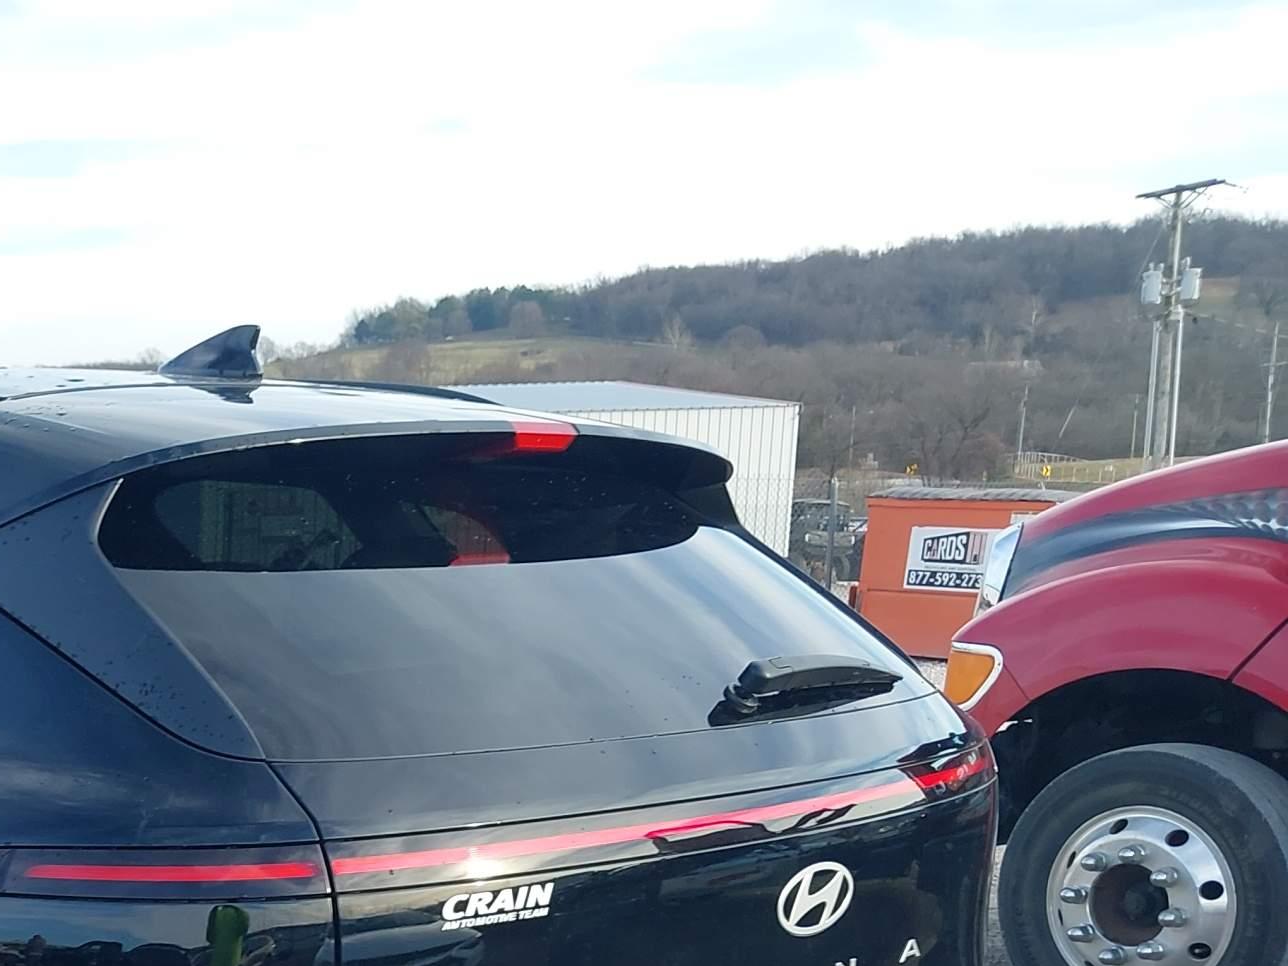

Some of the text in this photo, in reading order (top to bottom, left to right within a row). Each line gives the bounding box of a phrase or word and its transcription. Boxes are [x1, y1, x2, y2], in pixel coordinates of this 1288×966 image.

[923, 535, 968, 561] CARDS
[908, 571, 984, 588] 877-592-273
[442, 882, 555, 921] CRAIN
[441, 906, 550, 931] AUTOMOTIVE TEAM
